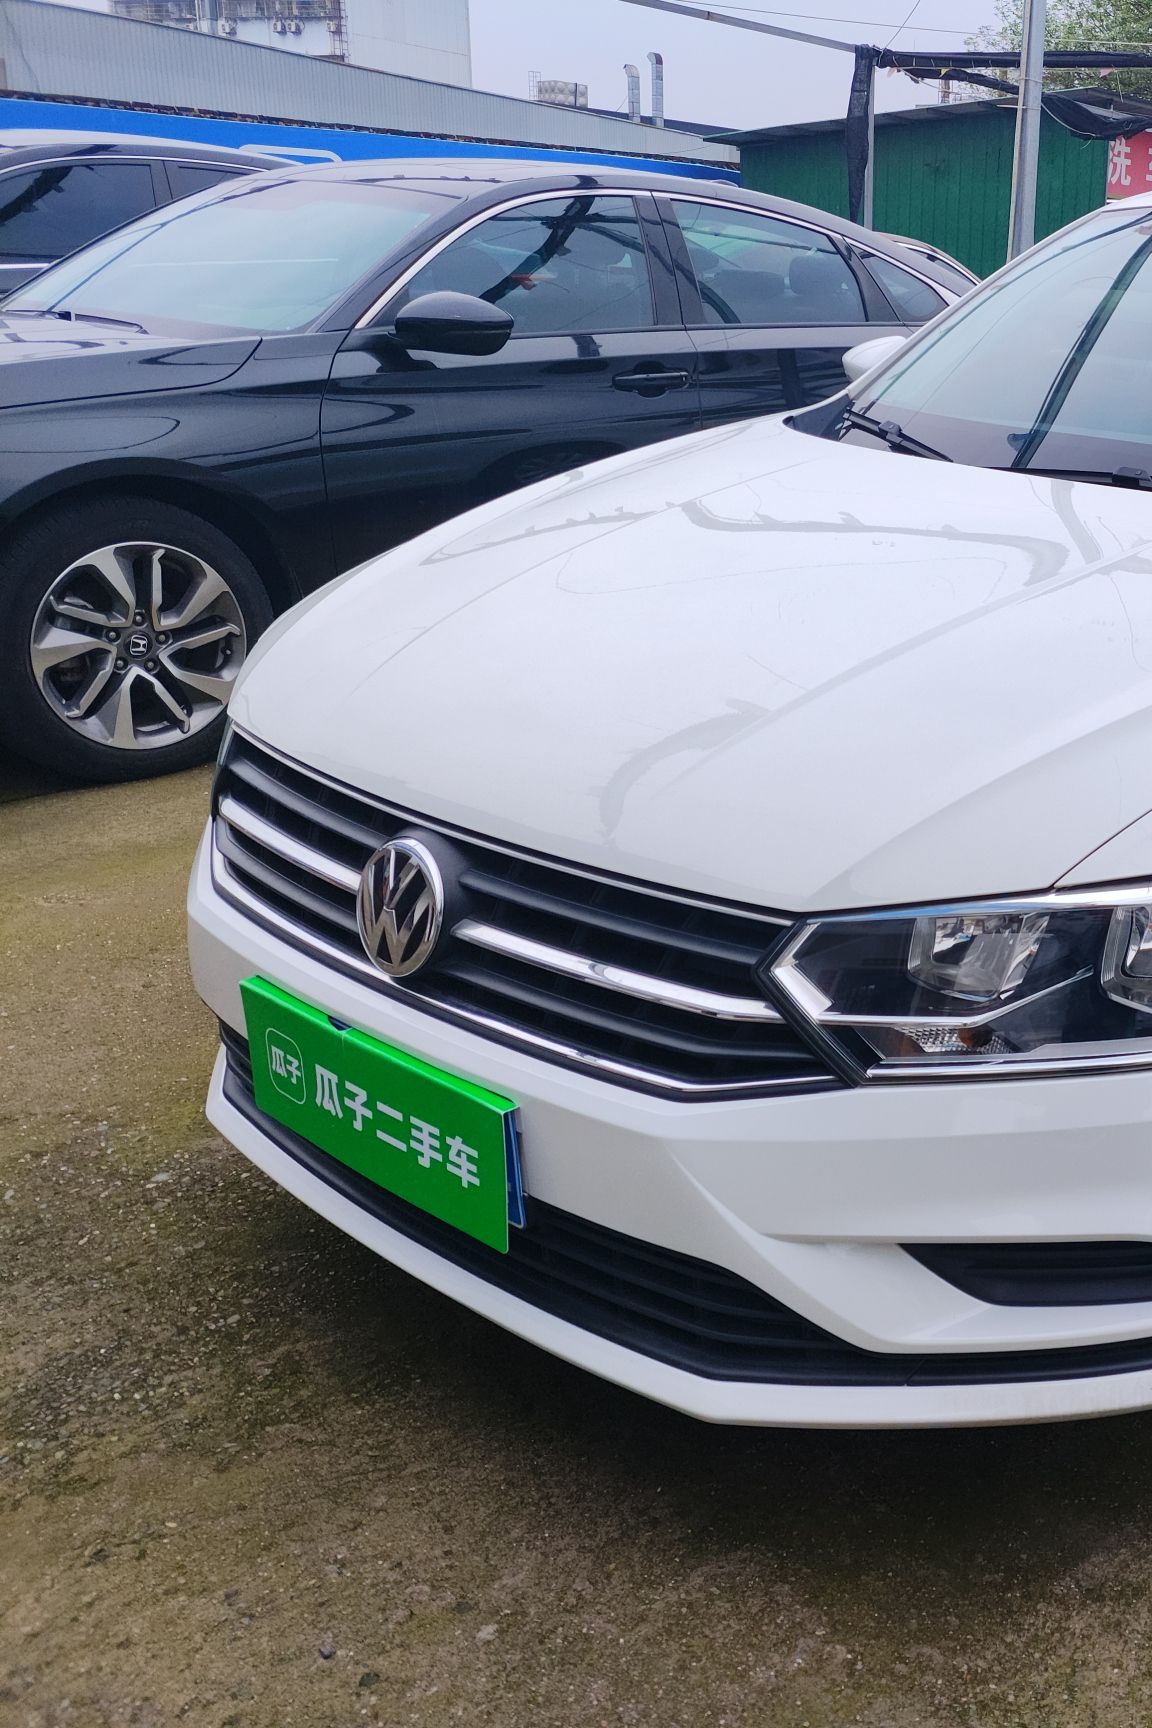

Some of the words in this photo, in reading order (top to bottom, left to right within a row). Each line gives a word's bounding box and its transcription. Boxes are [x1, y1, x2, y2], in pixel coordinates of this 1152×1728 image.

[270, 1044, 302, 1085] 瓜子
[314, 1063, 481, 1189] 瓜子二手车
